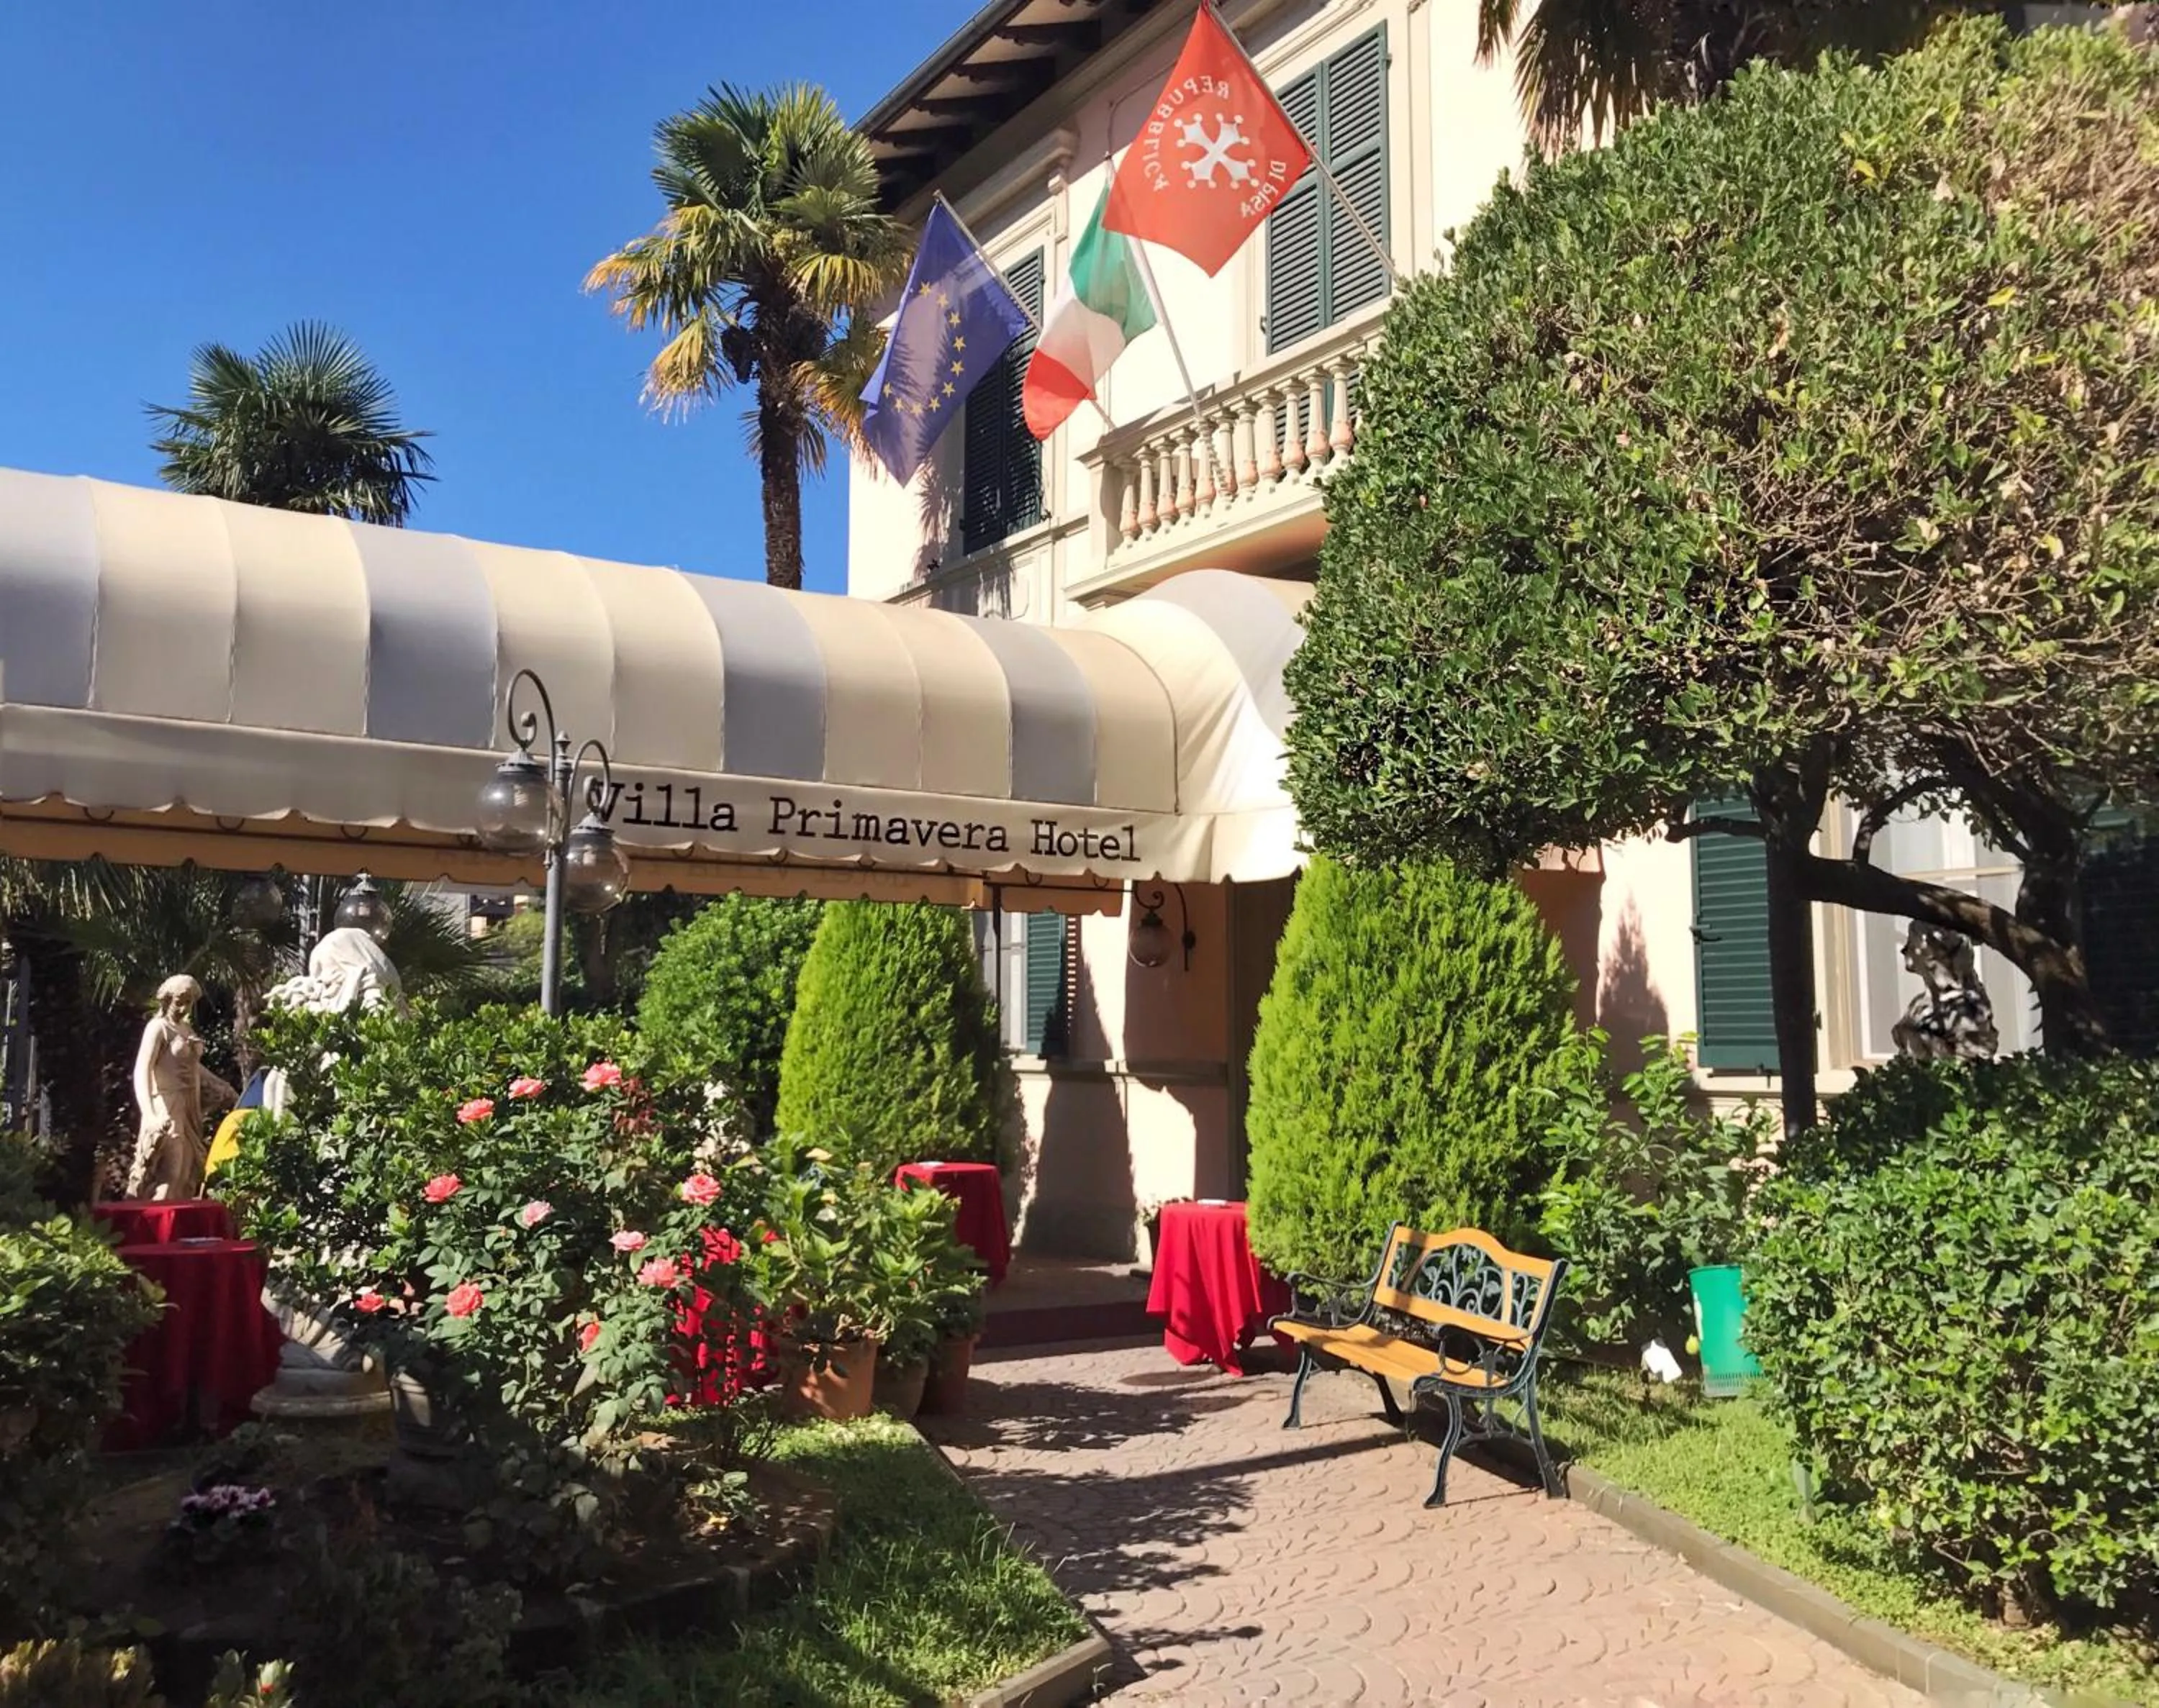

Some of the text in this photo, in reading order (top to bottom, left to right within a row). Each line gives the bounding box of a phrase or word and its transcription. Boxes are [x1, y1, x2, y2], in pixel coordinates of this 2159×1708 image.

[592, 781, 1141, 863] Villa Primavera Hotel
